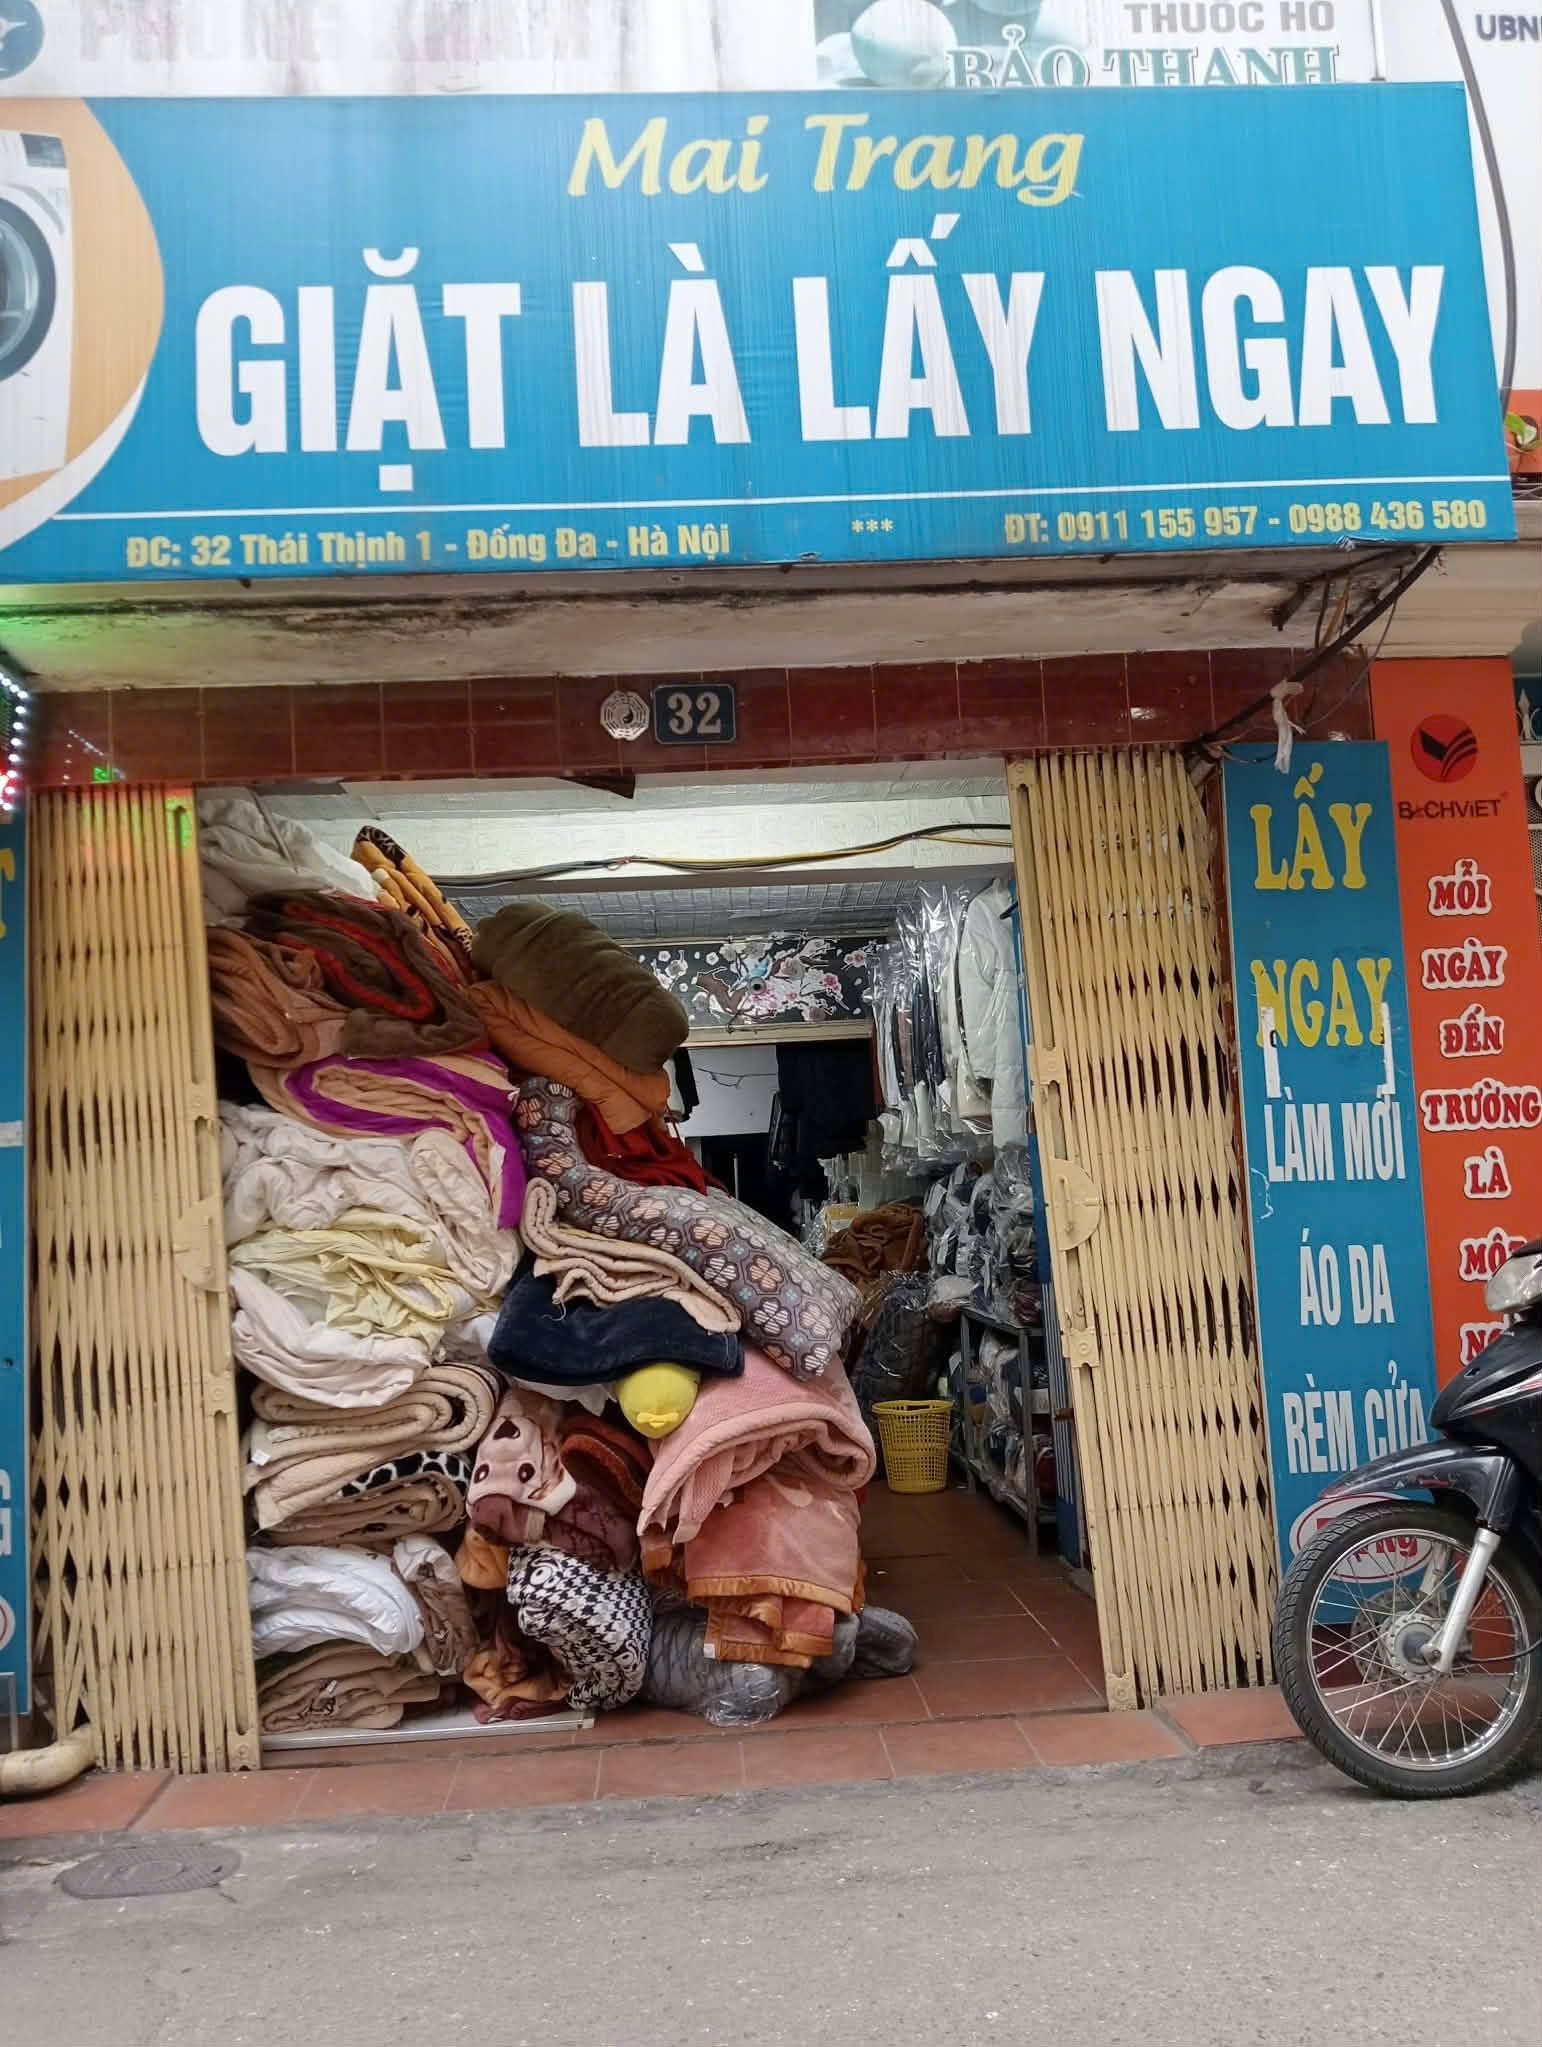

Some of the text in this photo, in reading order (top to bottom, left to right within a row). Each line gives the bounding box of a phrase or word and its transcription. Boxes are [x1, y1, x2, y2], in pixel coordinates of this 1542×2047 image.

[1476, 14, 1542, 42] UBN
[567, 113, 1084, 208] Mai Trang
[195, 213, 1445, 493] GIẶT LÀ LẤY NGAY
[126, 535, 181, 568] ĐC:
[191, 534, 231, 566] 32
[239, 532, 308, 566] Thái
[317, 531, 406, 569] Thịnh
[416, 530, 432, 561] 1
[466, 523, 547, 562] Đống
[555, 527, 597, 559] Đa
[628, 524, 669, 557] Hà
[677, 522, 731, 561] Nội
[1004, 513, 1050, 544] ĐT:
[1057, 510, 1129, 542] 0911
[1141, 508, 1197, 539] 155
[1204, 505, 1258, 537] 957
[1289, 502, 1362, 534] 0988
[1370, 501, 1425, 530] 436
[1431, 499, 1488, 529] 580
[667, 691, 721, 735] 32
[1250, 763, 1372, 890] LẤY
[1433, 860, 1488, 911] MỖI
[1426, 938, 1502, 984] NGÀY
[1250, 957, 1392, 1048] NGAY
[1444, 1006, 1502, 1054] ĐẾN
[1425, 1081, 1541, 1126] TRƯỜNG
[1264, 1086, 1335, 1182] LÀM
[1469, 1150, 1507, 1194] LÀ
[1300, 1227, 1396, 1326] ÁO DA
[1283, 1360, 1429, 1474] RÈM CỬA
